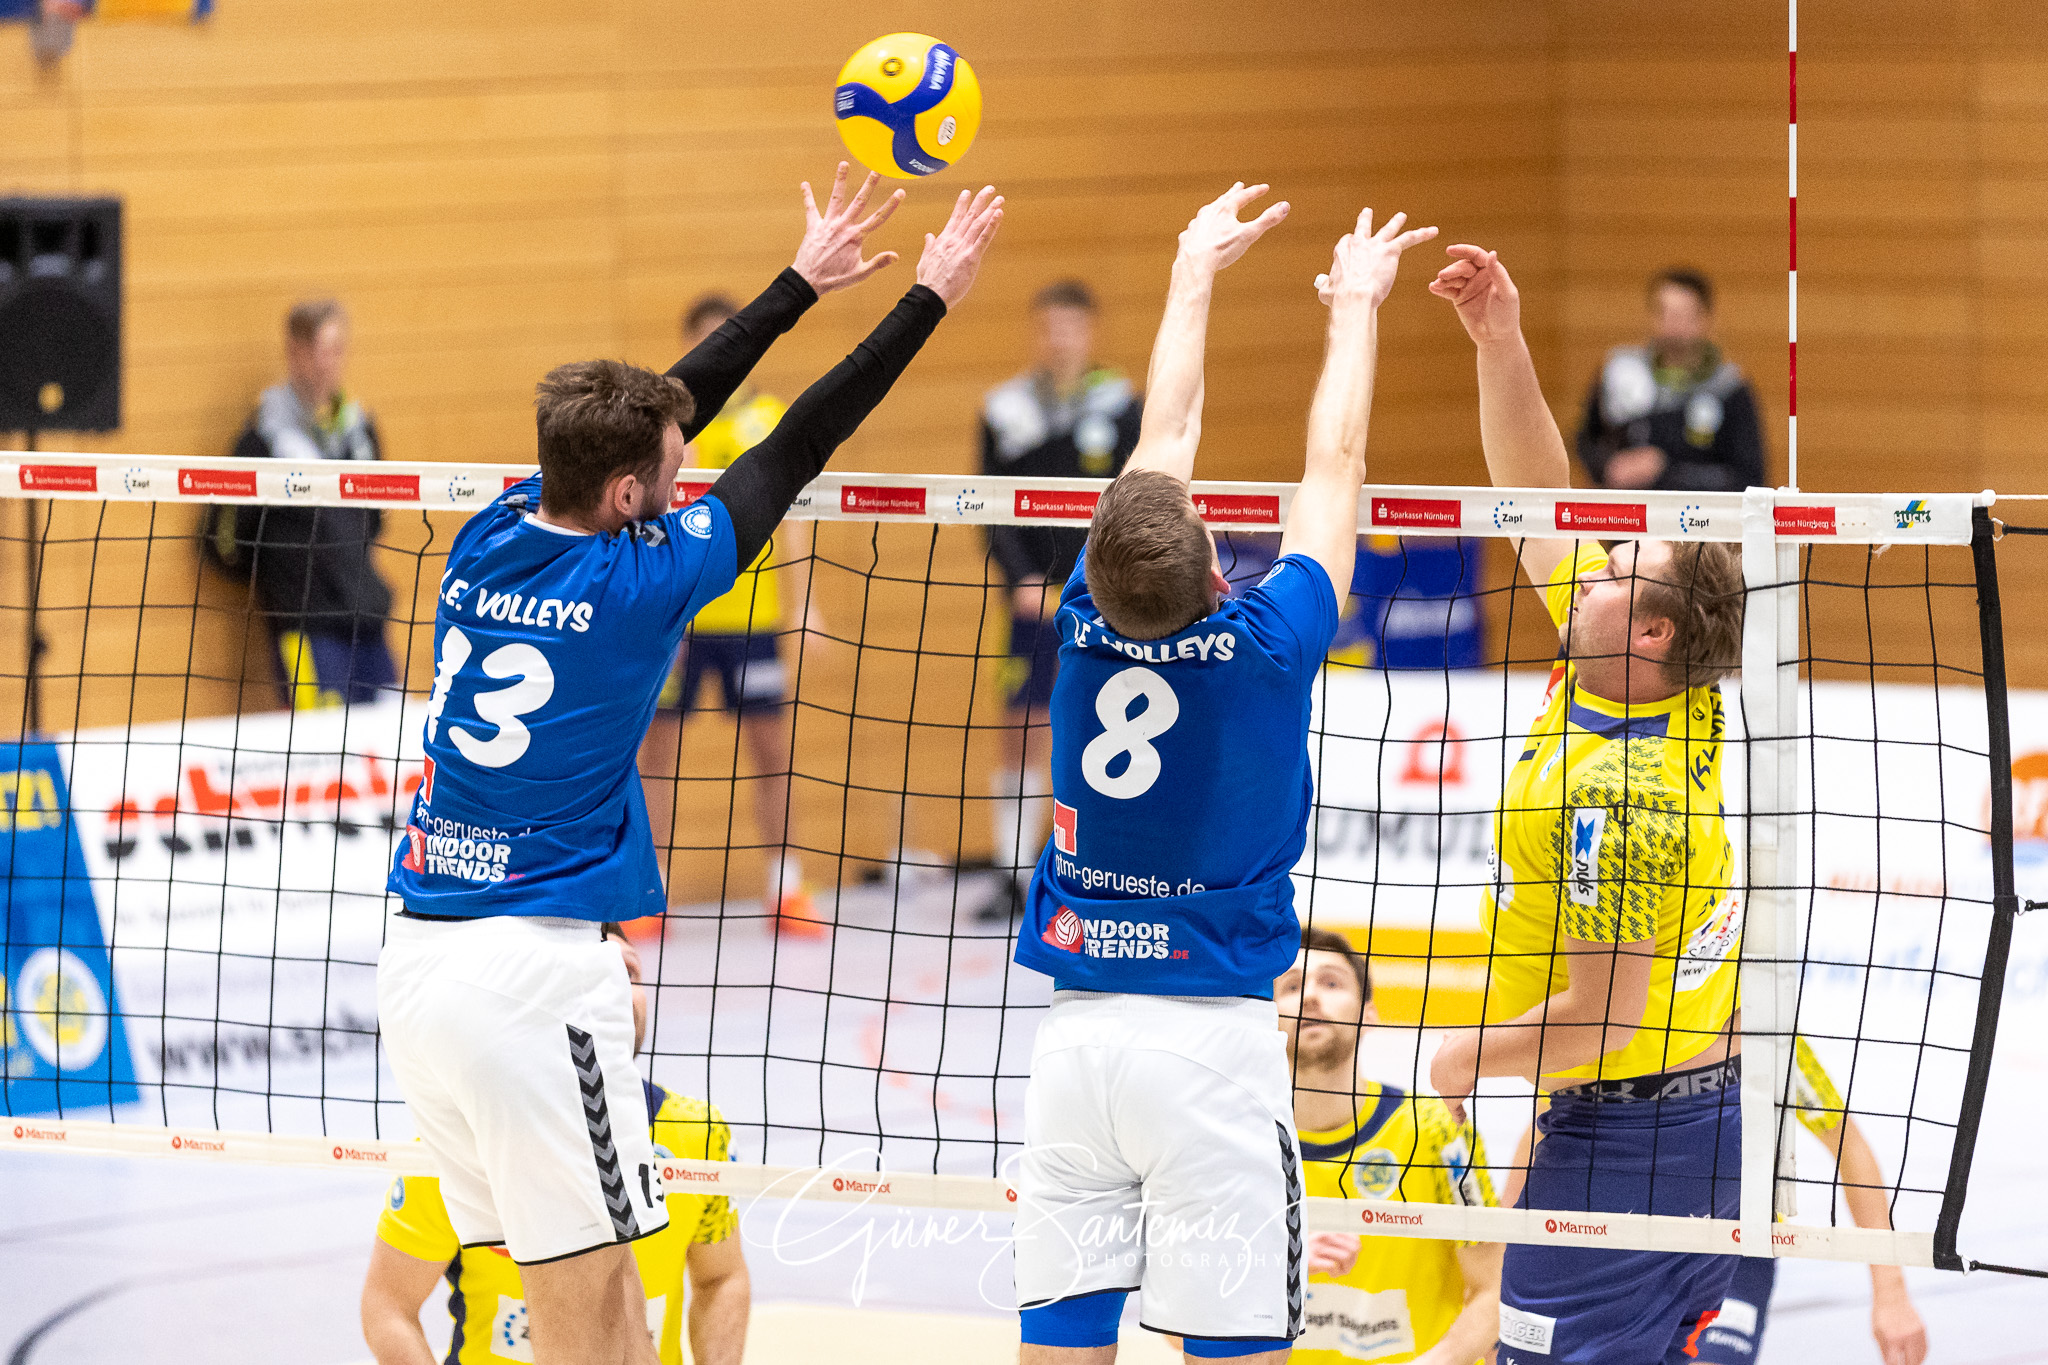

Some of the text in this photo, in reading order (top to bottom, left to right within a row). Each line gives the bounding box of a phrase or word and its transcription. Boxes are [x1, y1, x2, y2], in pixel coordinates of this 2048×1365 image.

[35, 475, 62, 487] Sparkasse
[132, 479, 150, 490] Zapf
[194, 480, 252, 493] Sparkasse Nürnberg
[293, 483, 311, 494] Zapf
[355, 484, 415, 497] Sparkasse Nürnberg
[456, 487, 475, 498] Zapf
[858, 497, 920, 511] Sparkasse Nürnberg
[964, 501, 984, 513] Zapf
[1032, 501, 1095, 515] Sparkasse Nürnberg
[1209, 505, 1273, 519] Sparkasse Nürnberg
[1389, 510, 1455, 524] Sparkasse Nürnberg
[1502, 512, 1523, 524] Zapf
[1894, 510, 1931, 524] HUCK
[1573, 514, 1640, 528] Sparkasse Nürnberg
[1688, 517, 1710, 529] Zapf
[1775, 519, 1796, 528] kasse
[476, 587, 594, 633] VOLLEYS
[428, 626, 555, 768] 13
[1081, 666, 1179, 799] 8
[426, 835, 511, 864] INDOOR
[426, 854, 506, 882] TRENDS
[25, 1127, 67, 1142] Marmot
[184, 1138, 225, 1152] Marmot
[345, 1148, 388, 1162] Marmot
[675, 1168, 720, 1183] Marmot
[638, 1163, 664, 1209] 1
[846, 1180, 892, 1194] Marmot
[1375, 1211, 1423, 1226] Marmot
[1559, 1221, 1608, 1236] Marmot
[1772, 1233, 1796, 1246] mot
